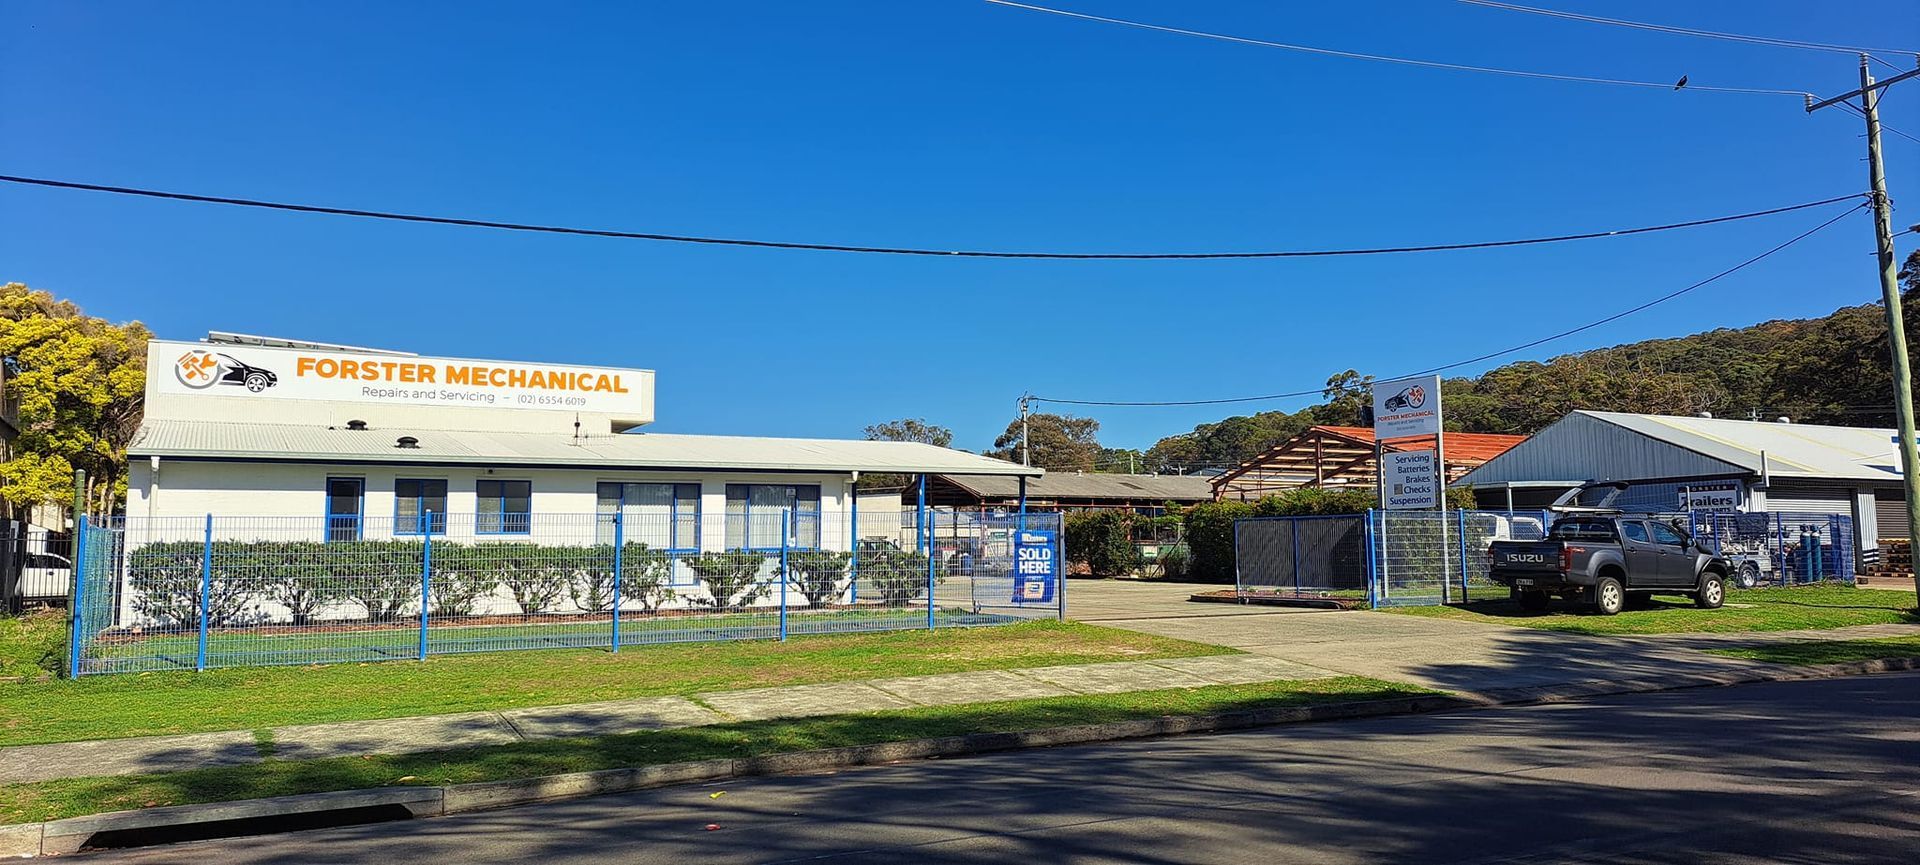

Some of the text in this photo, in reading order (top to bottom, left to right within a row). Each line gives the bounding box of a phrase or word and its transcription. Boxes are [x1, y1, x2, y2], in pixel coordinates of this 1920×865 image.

[297, 357, 628, 393] FORSTER MECHANICAL
[362, 387, 408, 399] Repairs
[412, 389, 436, 399] and
[440, 390, 495, 404] Servicing
[517, 394, 536, 405] (02)
[538, 395, 563, 405] 6554
[565, 396, 587, 406] 6019
[1377, 410, 1435, 422] FORSTER MECHANICAL
[1395, 455, 1430, 465] Servicing
[1398, 465, 1430, 474] Batteries
[1406, 475, 1431, 484] Brakes
[1403, 485, 1431, 494] Checks
[1389, 497, 1432, 507] Suspension
[1018, 548, 1051, 561] SOLD
[1506, 554, 1544, 563] ISUZU
[1019, 560, 1051, 574] HERE
